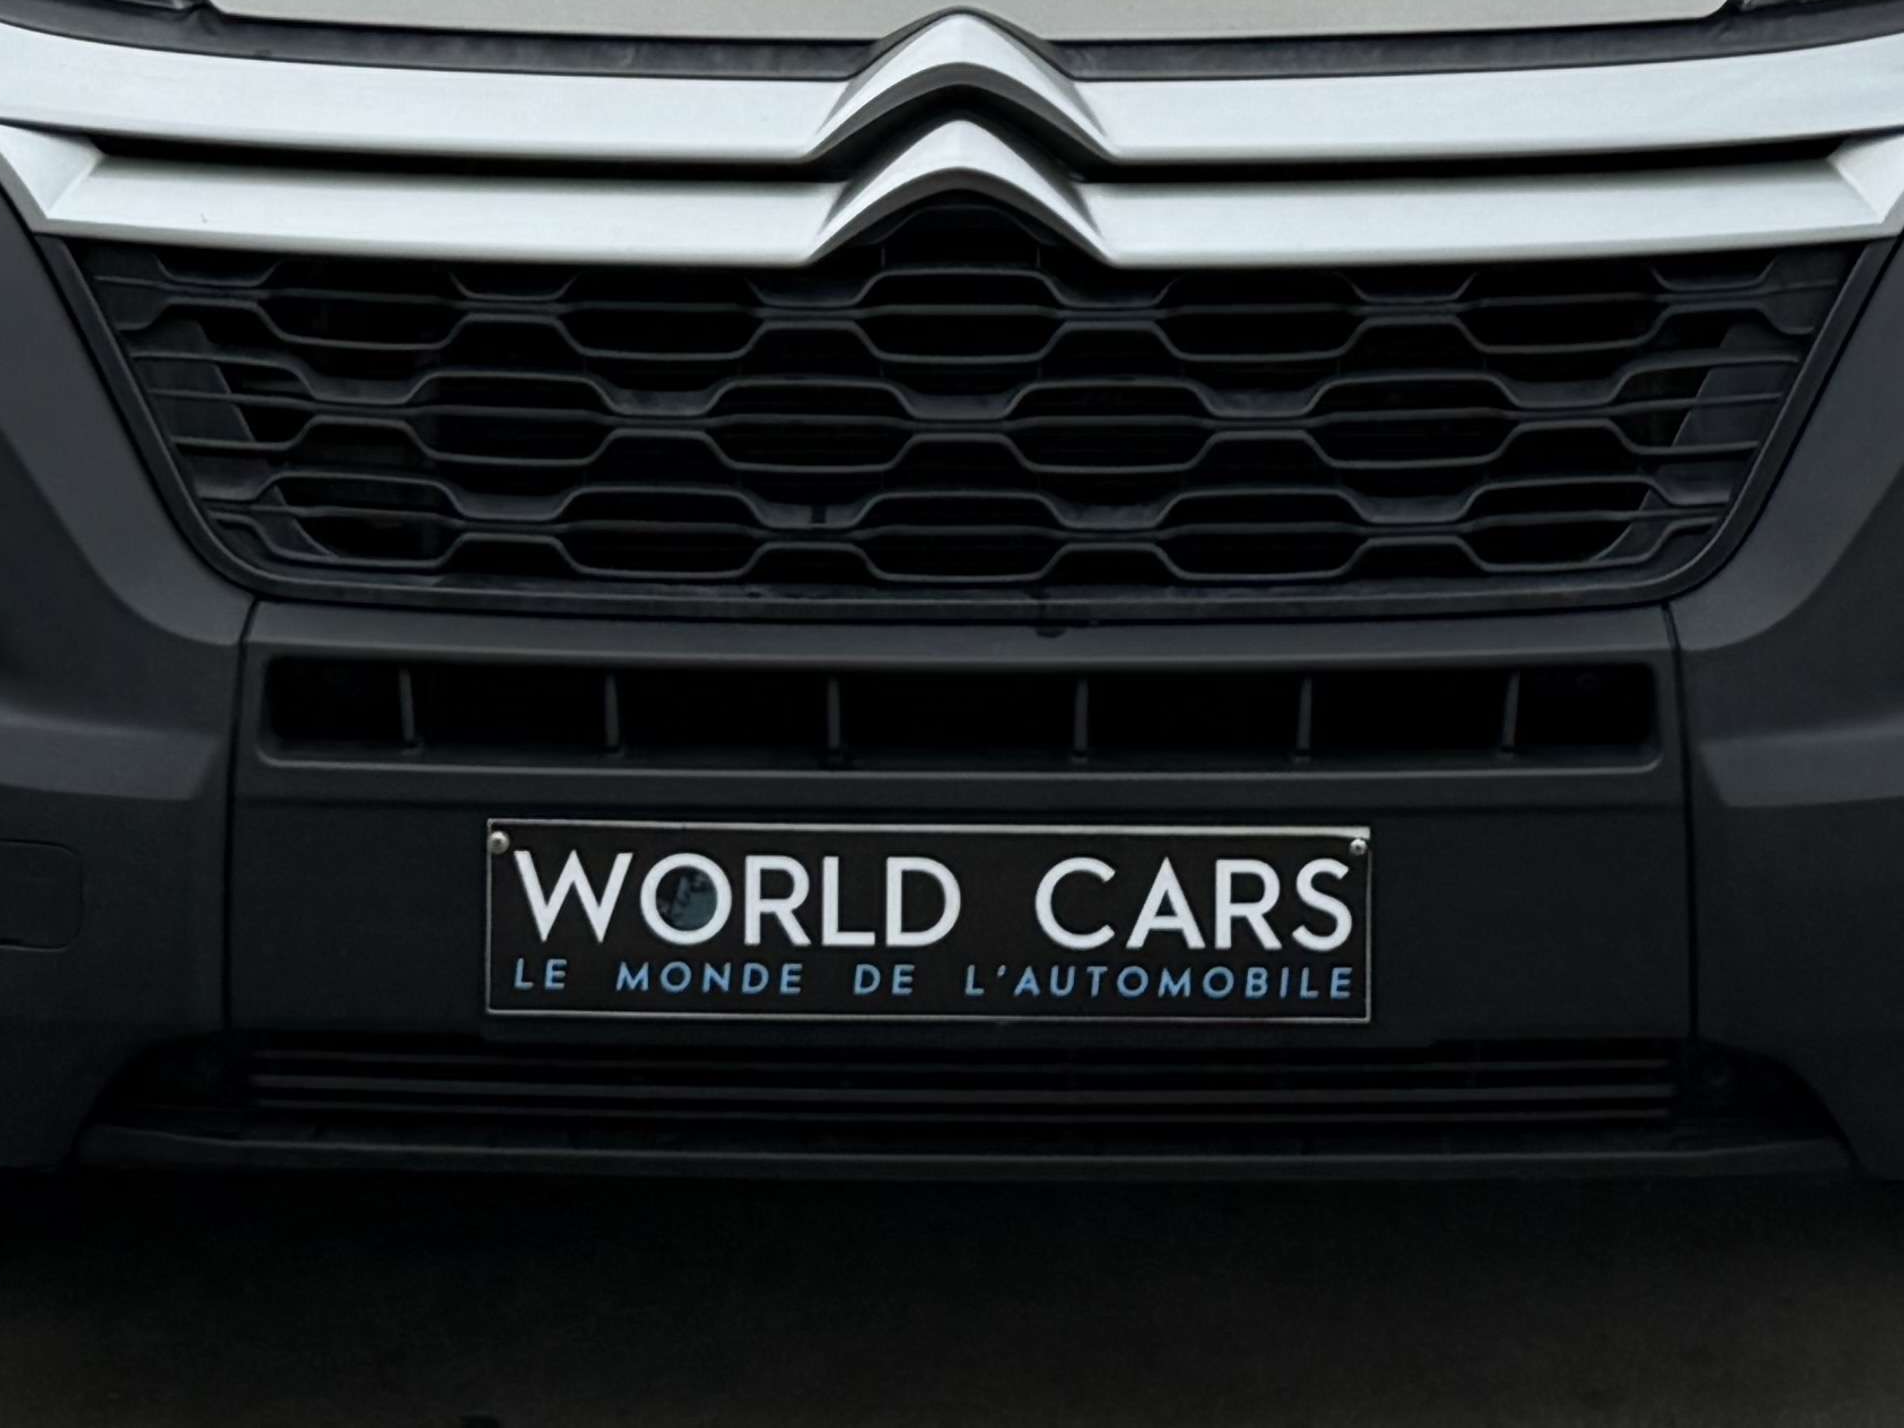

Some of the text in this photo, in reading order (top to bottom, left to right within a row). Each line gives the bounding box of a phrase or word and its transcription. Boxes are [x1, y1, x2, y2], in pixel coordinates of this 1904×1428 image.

[513, 848, 1354, 951] WORLD CARS
[514, 957, 1355, 1000] LE MONDE DE L'AUTOMOBILE
